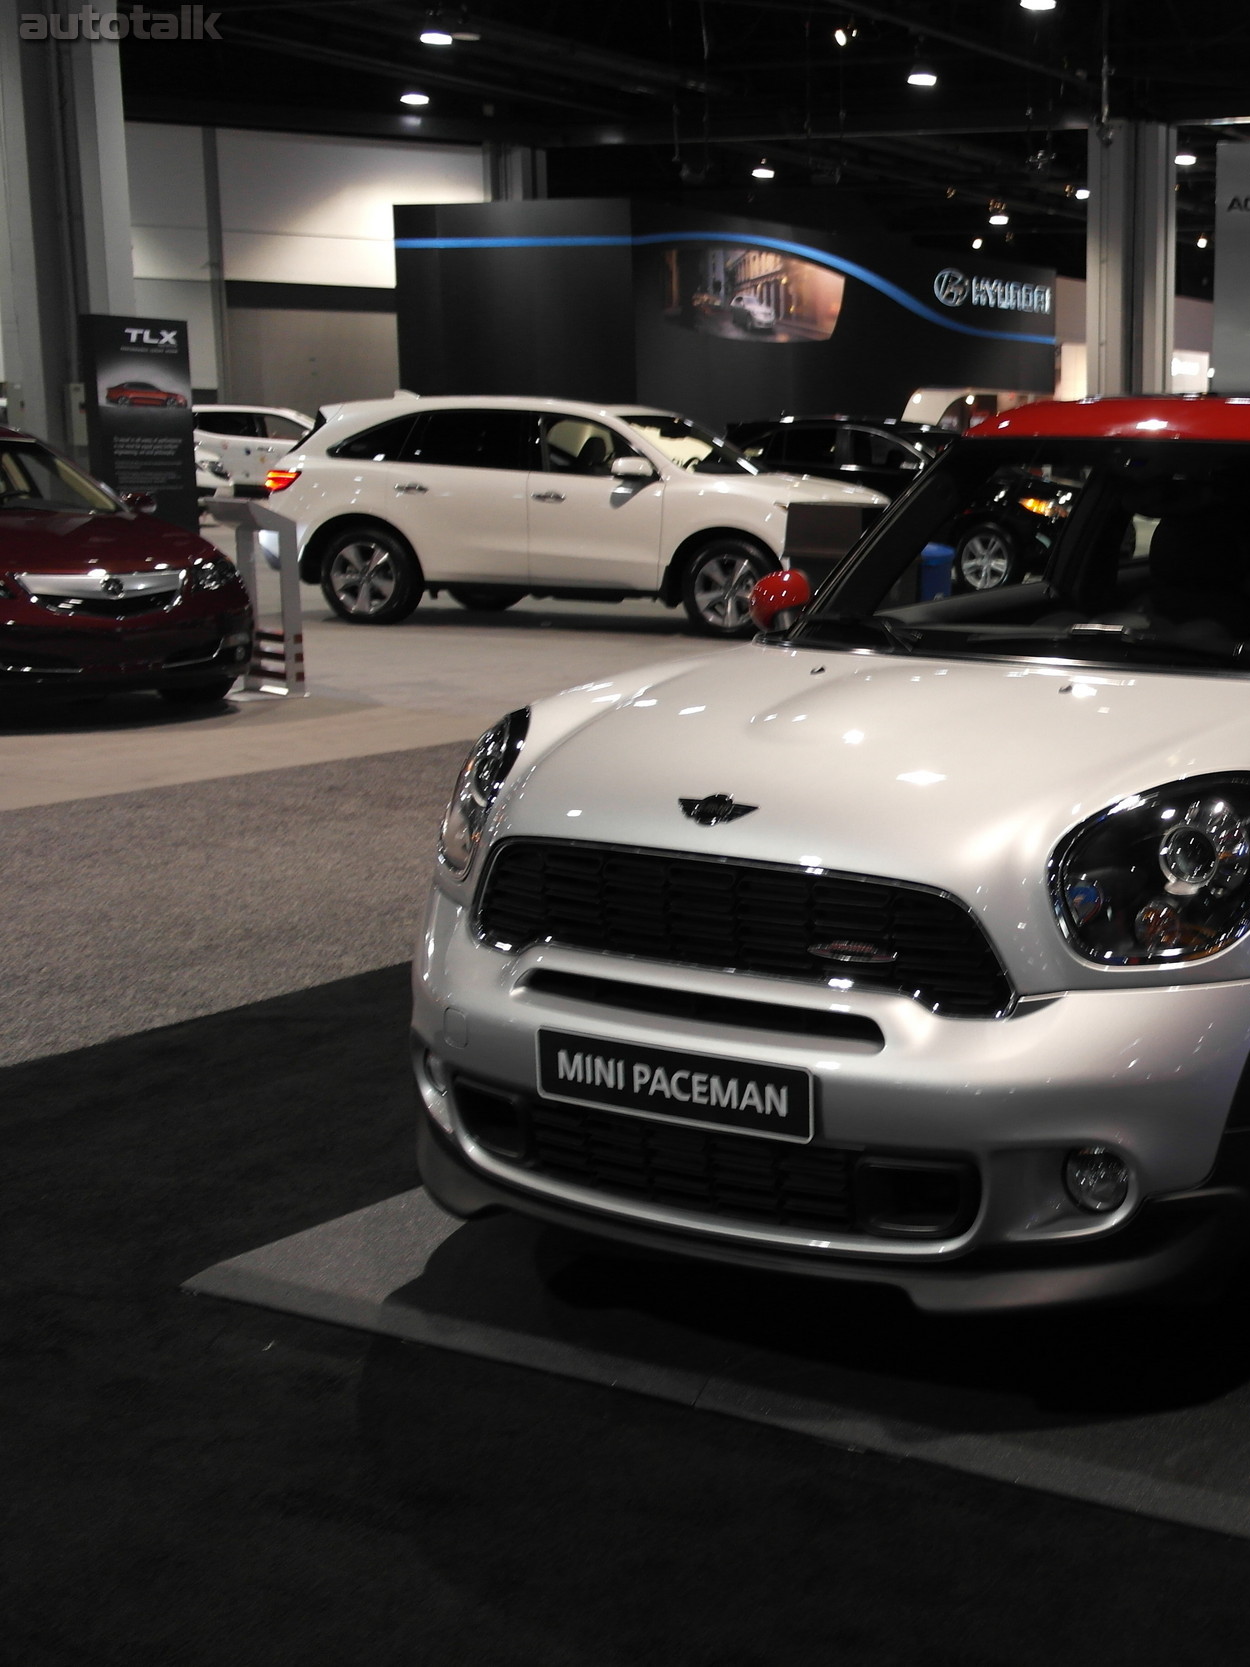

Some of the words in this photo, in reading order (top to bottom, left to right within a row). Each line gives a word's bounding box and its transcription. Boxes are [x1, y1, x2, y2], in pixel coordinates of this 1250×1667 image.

[971, 276, 1052, 315] HYUNDAI
[124, 328, 178, 345] TLX
[558, 1050, 625, 1090] MINI
[633, 1063, 788, 1117] PACEMAN
